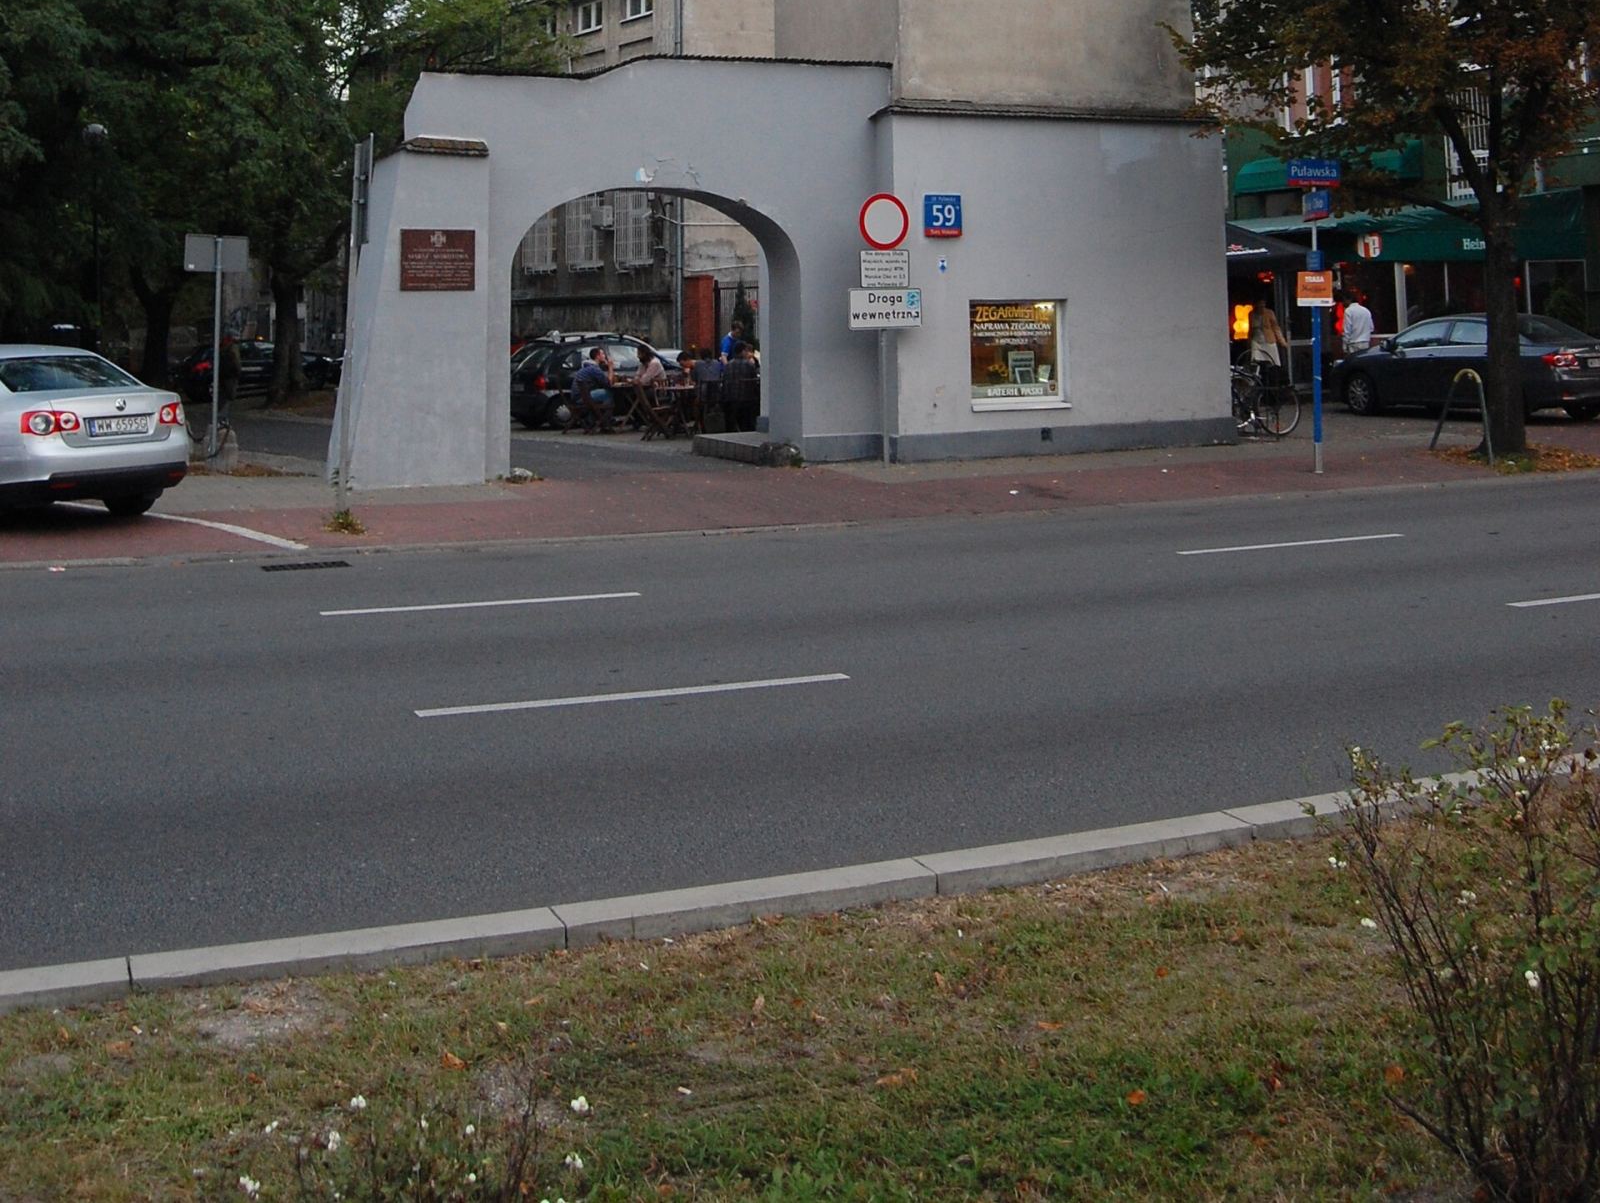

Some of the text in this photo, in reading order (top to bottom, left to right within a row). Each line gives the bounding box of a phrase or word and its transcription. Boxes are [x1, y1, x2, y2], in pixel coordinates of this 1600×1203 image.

[932, 204, 955, 226] 59
[1462, 238, 1486, 250] Hein
[868, 292, 903, 306] Droga
[973, 322, 1009, 330] NAPRAWA
